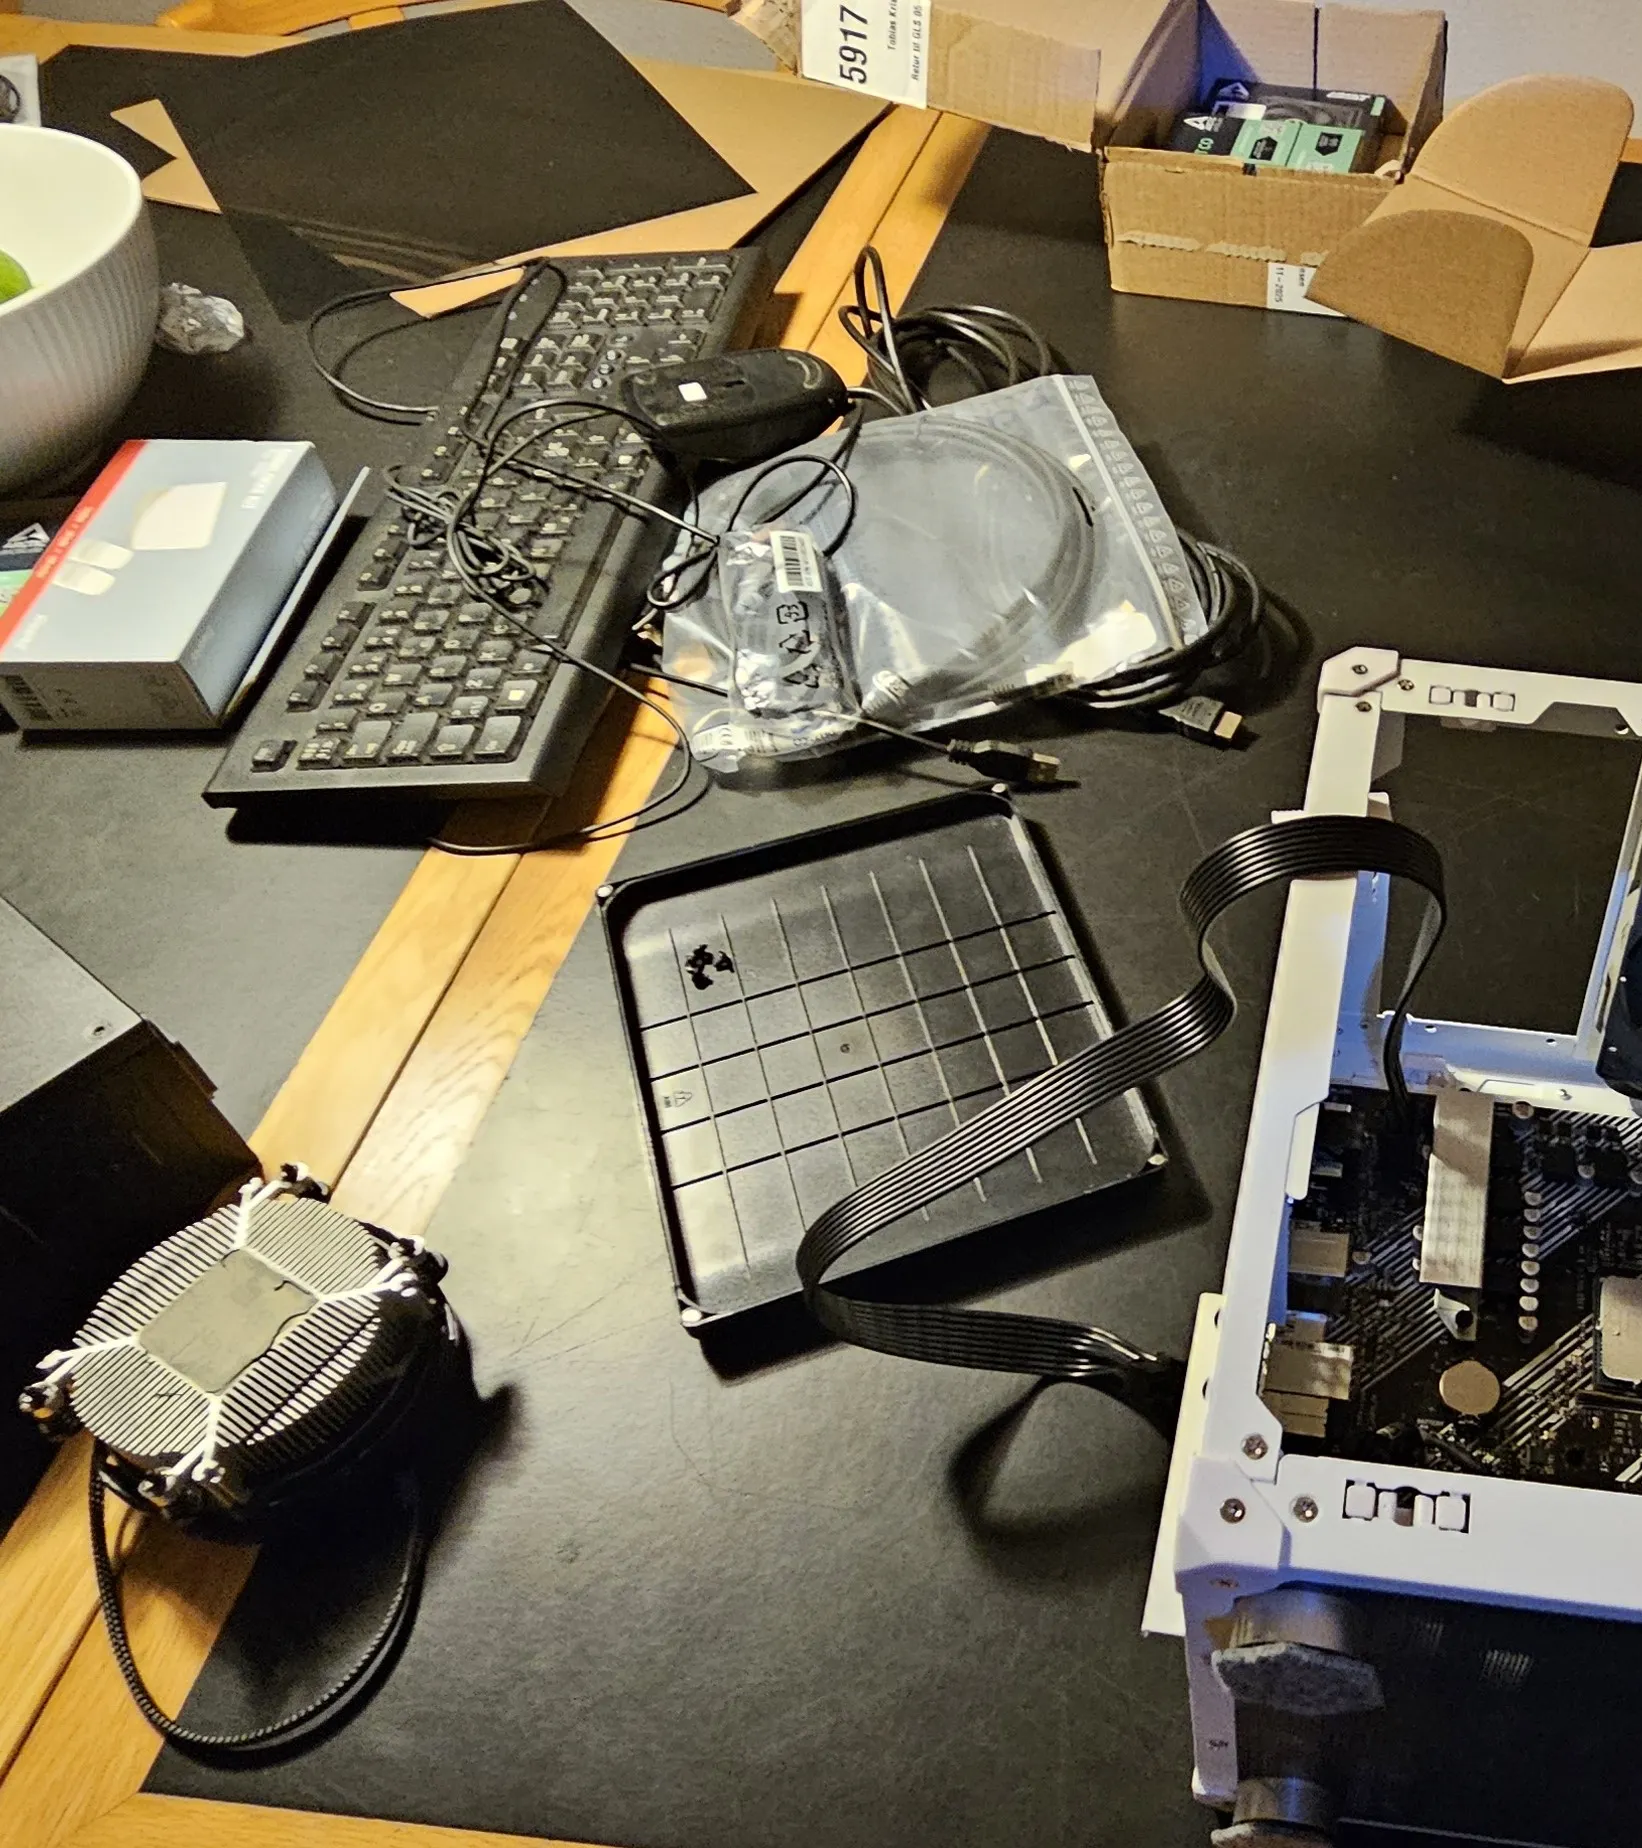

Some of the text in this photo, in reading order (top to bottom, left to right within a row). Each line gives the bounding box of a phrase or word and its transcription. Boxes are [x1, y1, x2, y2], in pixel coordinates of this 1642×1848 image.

[888, 20, 898, 50] Tobias
[912, 20, 922, 39] GLS
[839, 4, 868, 84] 5917
[911, 54, 921, 81] Retur
